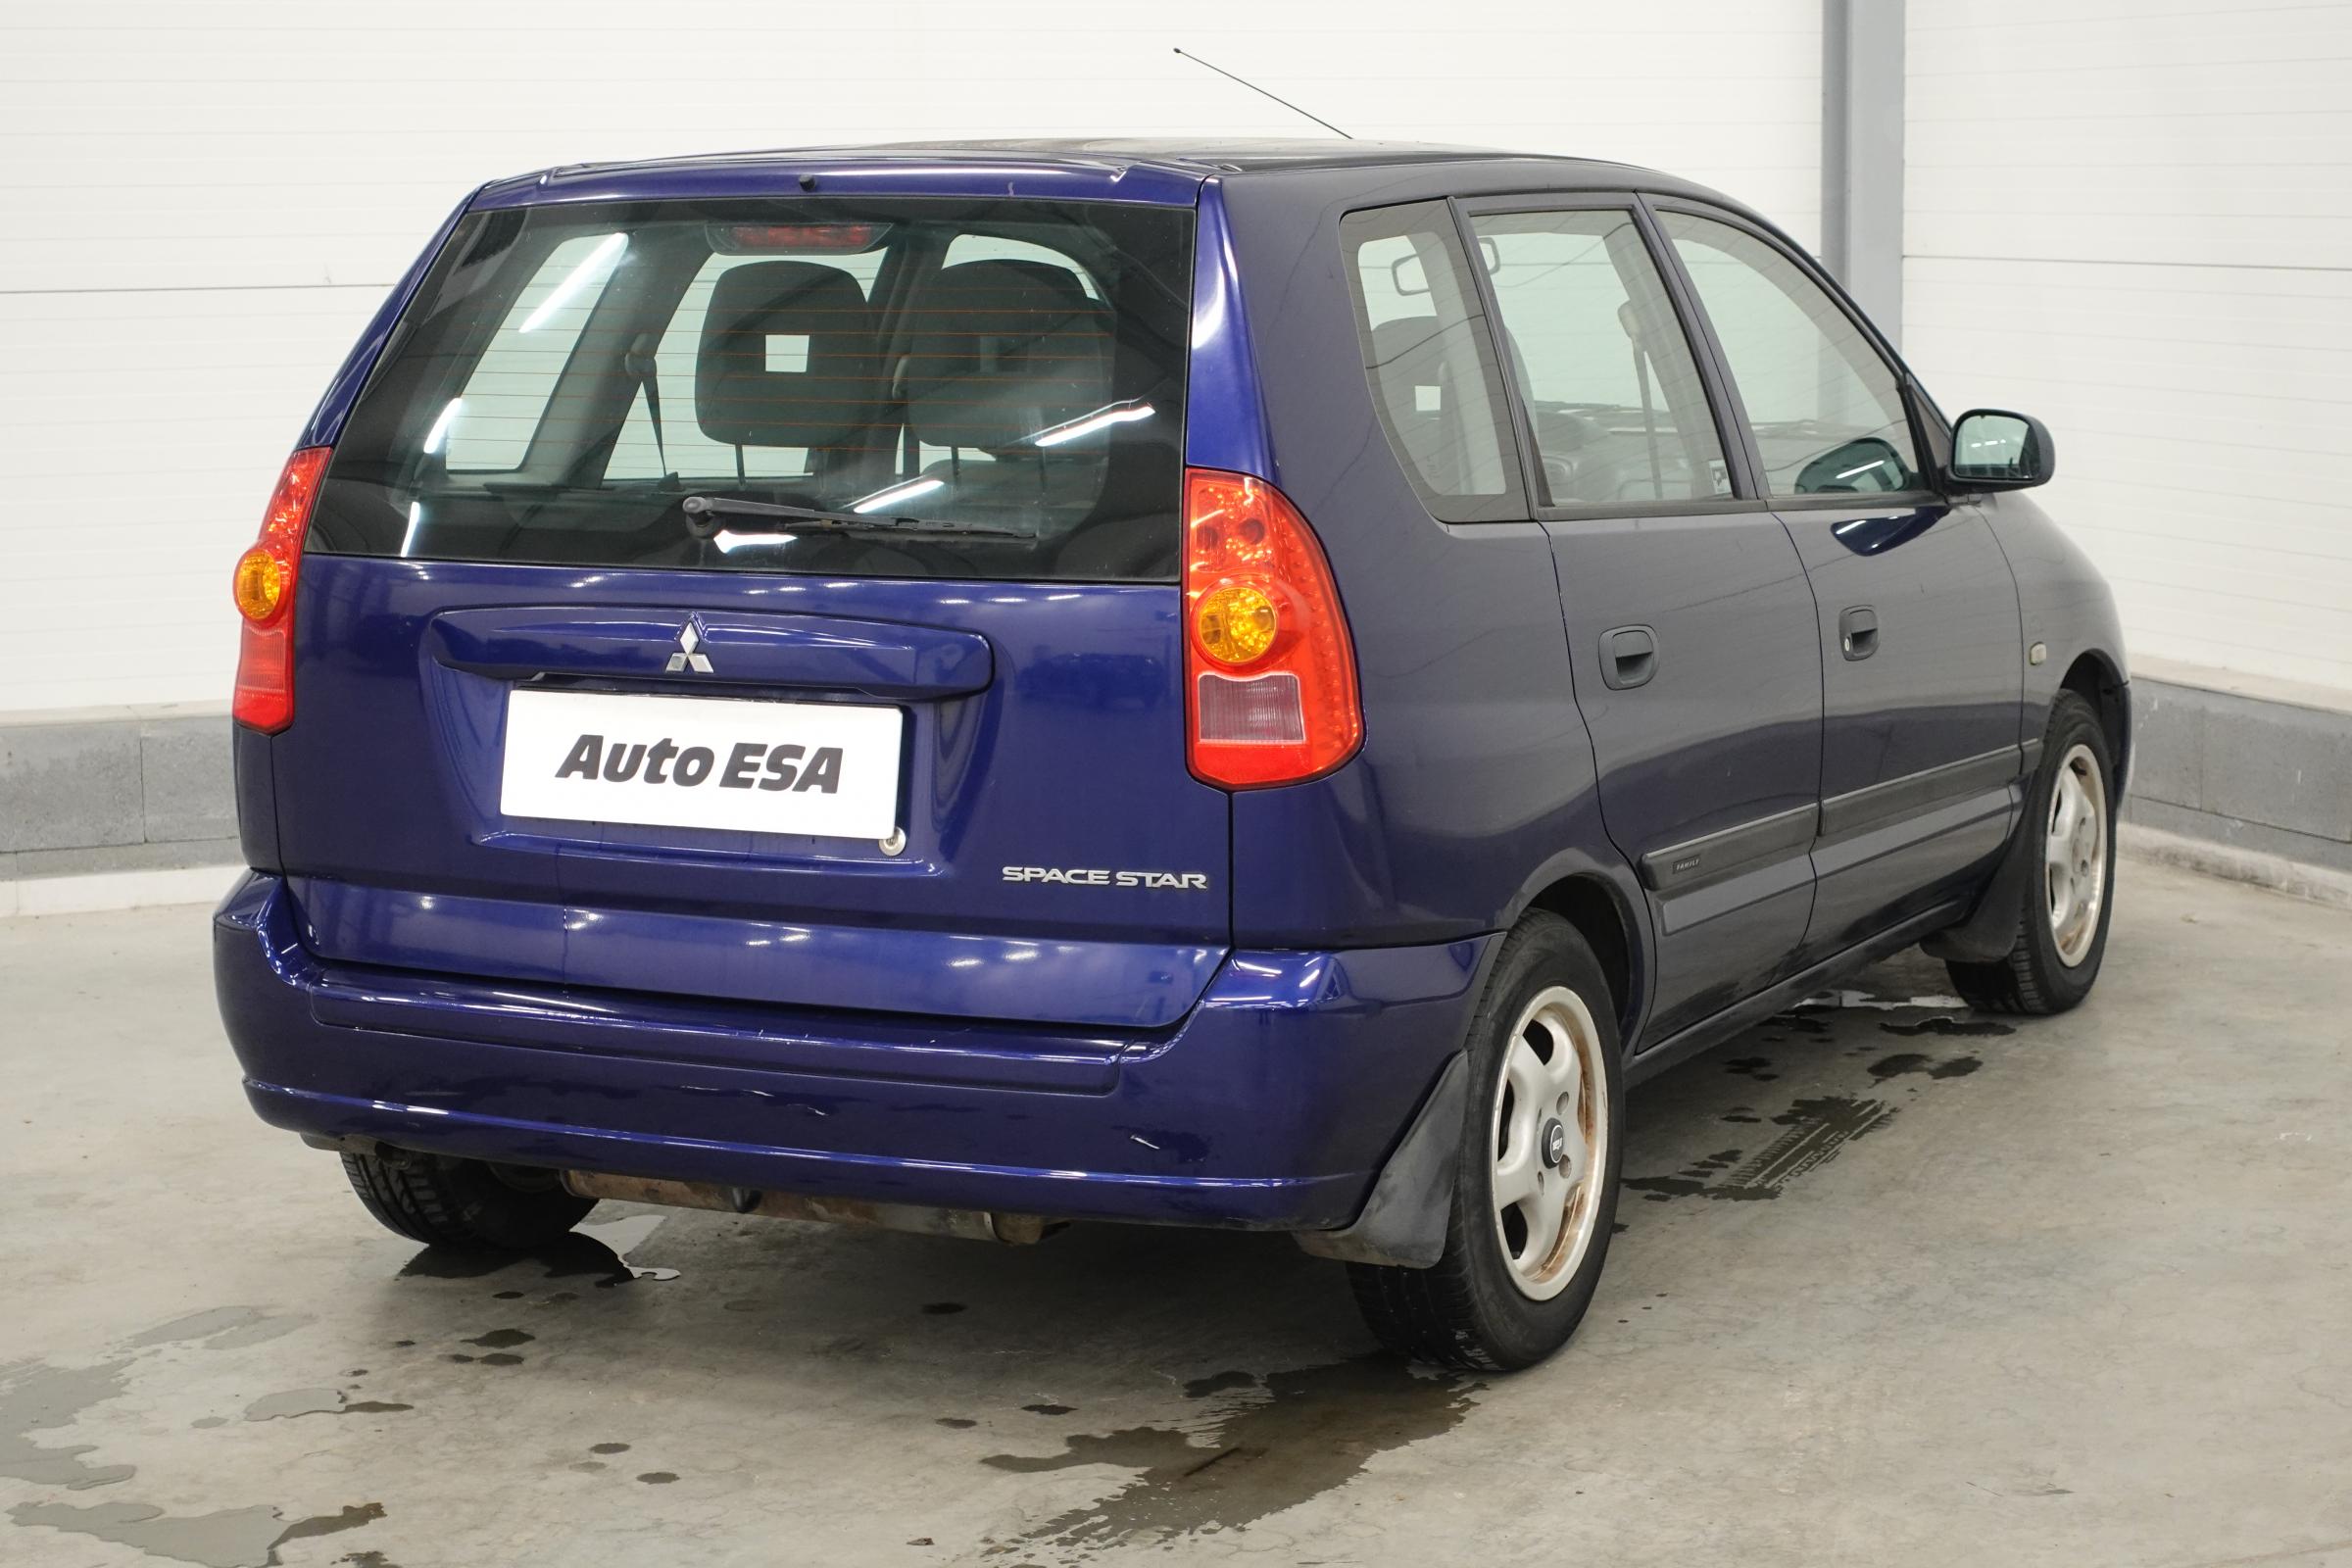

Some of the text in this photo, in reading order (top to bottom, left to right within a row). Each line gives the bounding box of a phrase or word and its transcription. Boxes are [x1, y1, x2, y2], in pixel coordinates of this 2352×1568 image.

[555, 734, 844, 795] Auto ESA
[1002, 865, 1207, 889] SPACE STAR
